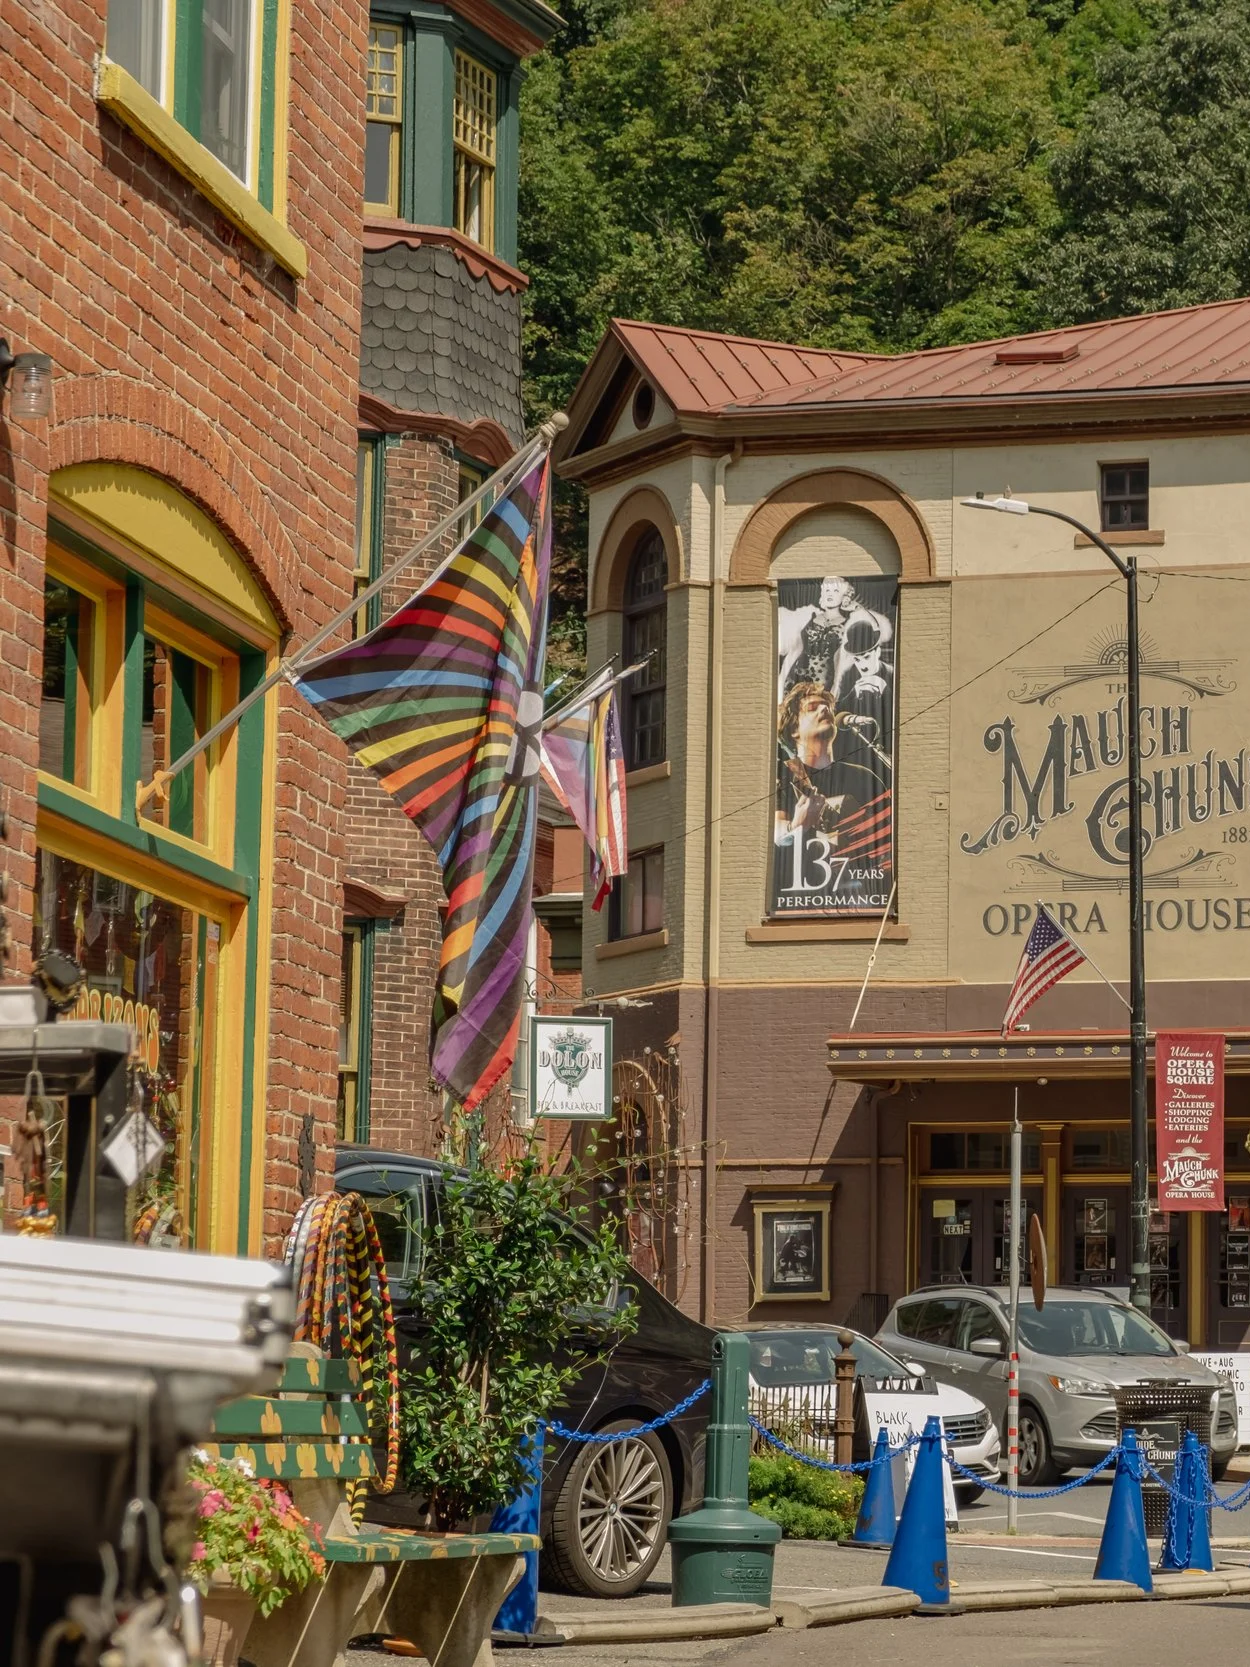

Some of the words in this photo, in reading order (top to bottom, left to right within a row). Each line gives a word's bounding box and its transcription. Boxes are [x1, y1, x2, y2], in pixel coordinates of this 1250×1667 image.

[1105, 683, 1128, 694] TH
[961, 696, 1190, 855] MAUCH
[780, 825, 849, 892] 137
[848, 869, 884, 879] YEARS
[777, 894, 889, 907] PERFORMANCE
[1170, 1046, 1205, 1057] Welcome
[539, 1050, 603, 1069] DOLON
[1167, 1059, 1215, 1068] OPERA
[1167, 1068, 1215, 1077] HOUSE
[1166, 1076, 1215, 1085] SQUARE
[1172, 1088, 1206, 1099] Discover
[560, 1101, 602, 1112] BREAKFAST
[1175, 1134, 1191, 1144] and
[1191, 1134, 1203, 1144] the
[1160, 1159, 1203, 1184] MAUCH
[1180, 1168, 1220, 1188] CHUNK
[1192, 1191, 1216, 1199] HOUSE
[944, 1225, 963, 1234] NEXT
[1219, 1358, 1234, 1367] AUG
[876, 1411, 912, 1425] BLACK
